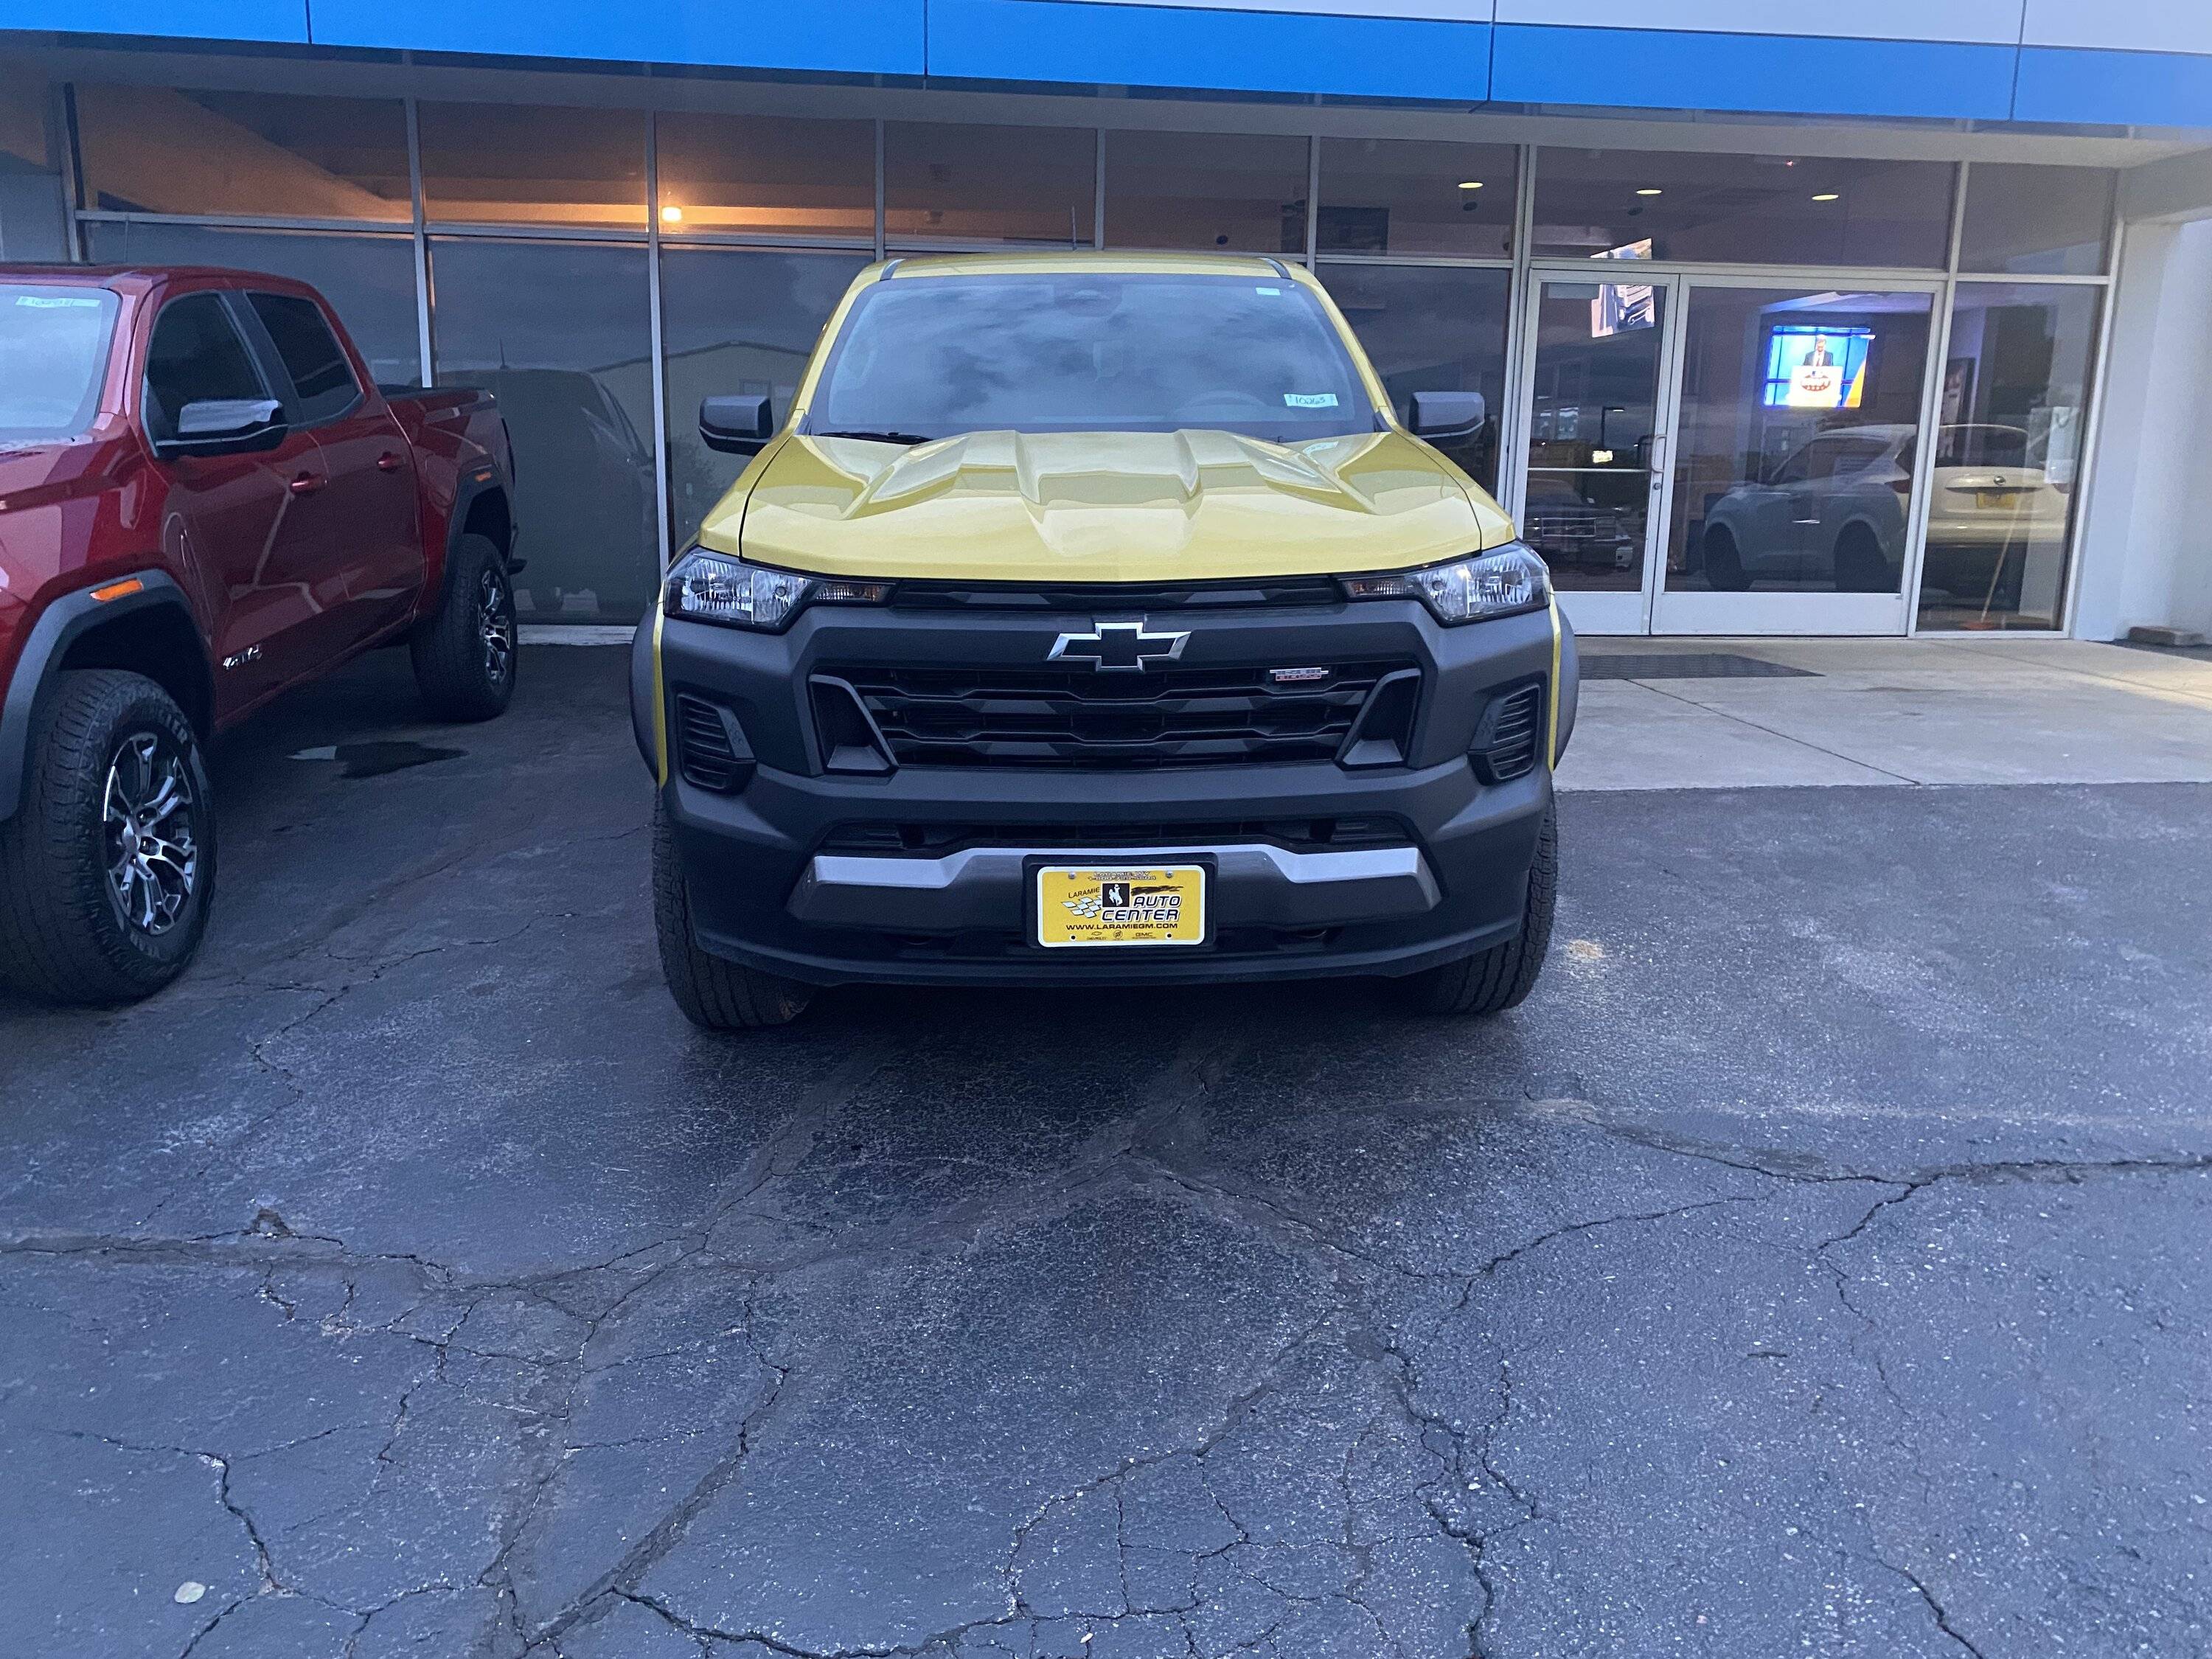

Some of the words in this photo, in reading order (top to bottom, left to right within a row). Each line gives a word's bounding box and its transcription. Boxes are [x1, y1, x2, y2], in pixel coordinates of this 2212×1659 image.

[1068, 887, 1101, 899] LARAMIE
[1133, 895, 1183, 908] AUTO
[1102, 908, 1181, 922] CENTER
